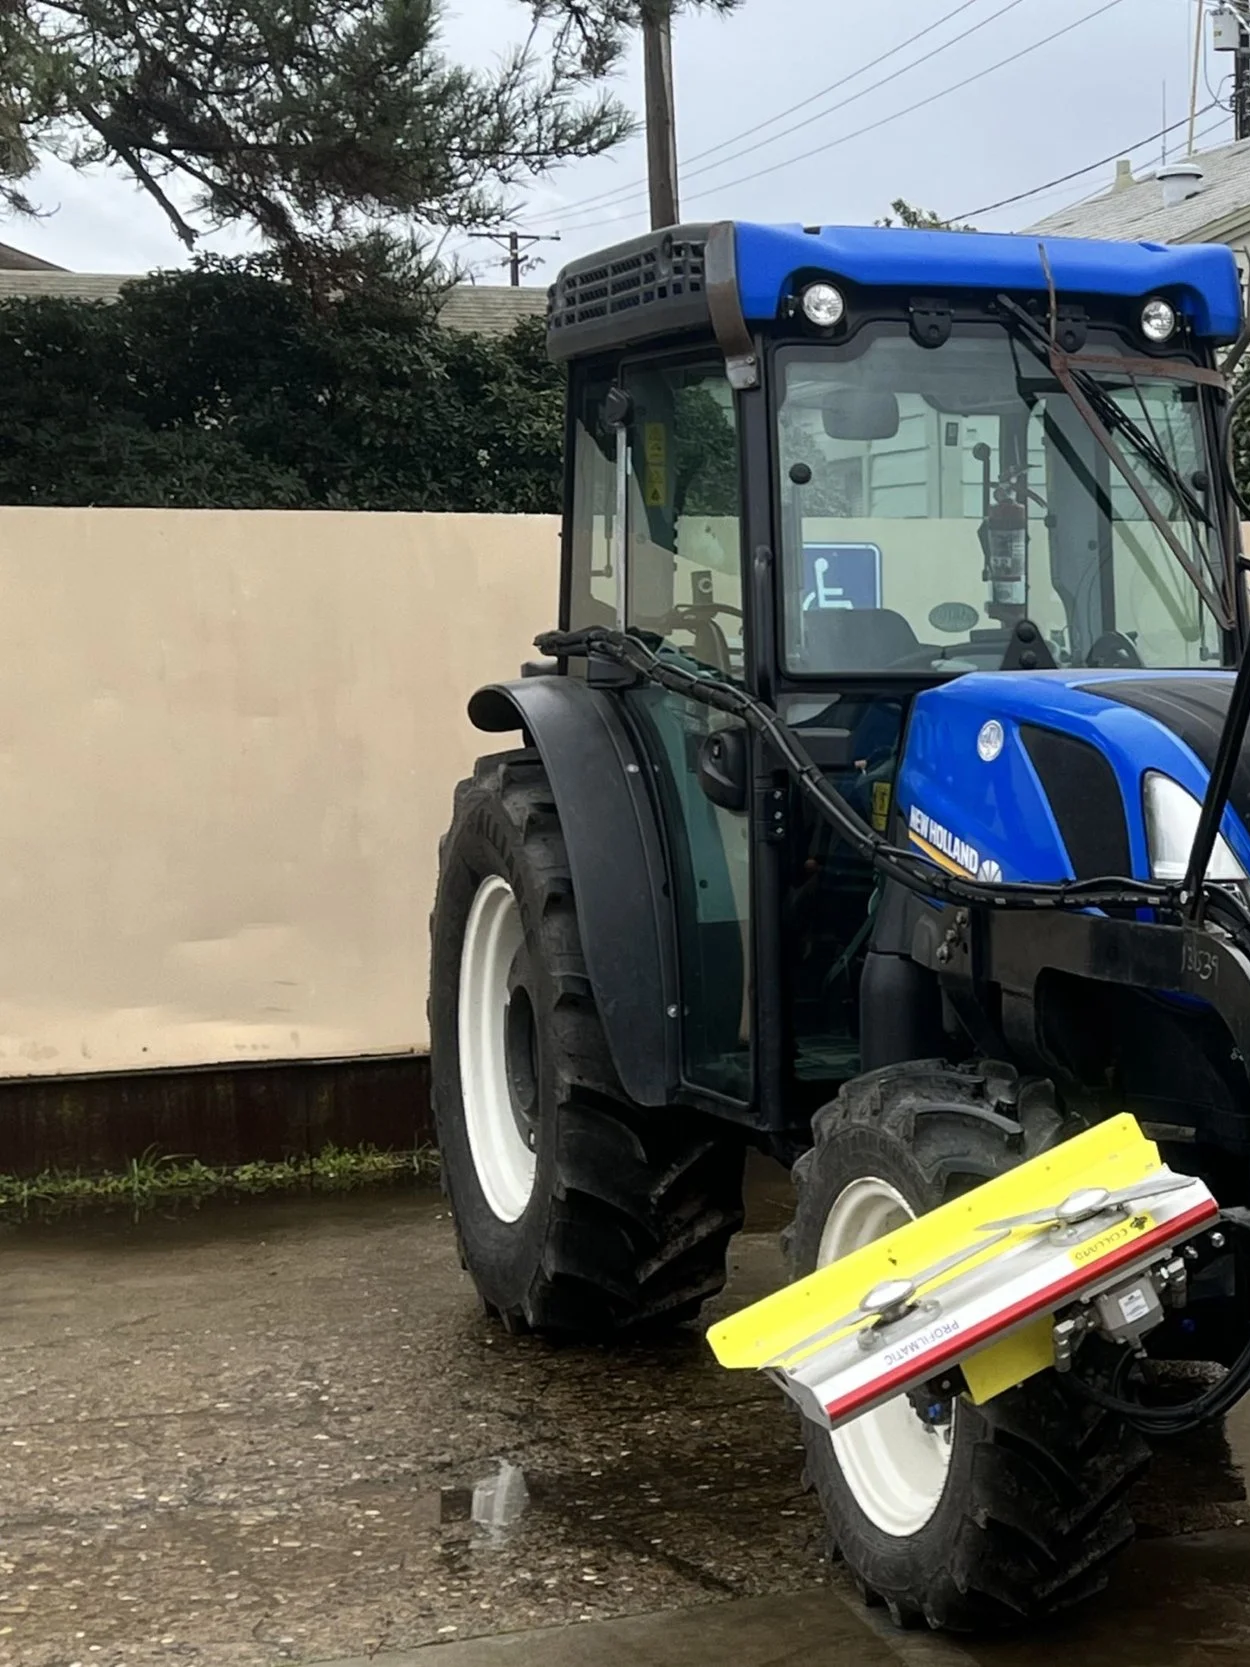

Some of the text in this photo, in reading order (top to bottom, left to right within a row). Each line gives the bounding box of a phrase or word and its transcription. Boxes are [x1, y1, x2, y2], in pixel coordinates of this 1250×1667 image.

[909, 804, 979, 875] NEW HOLLAND
[884, 1320, 960, 1366] PROFILMATIC
